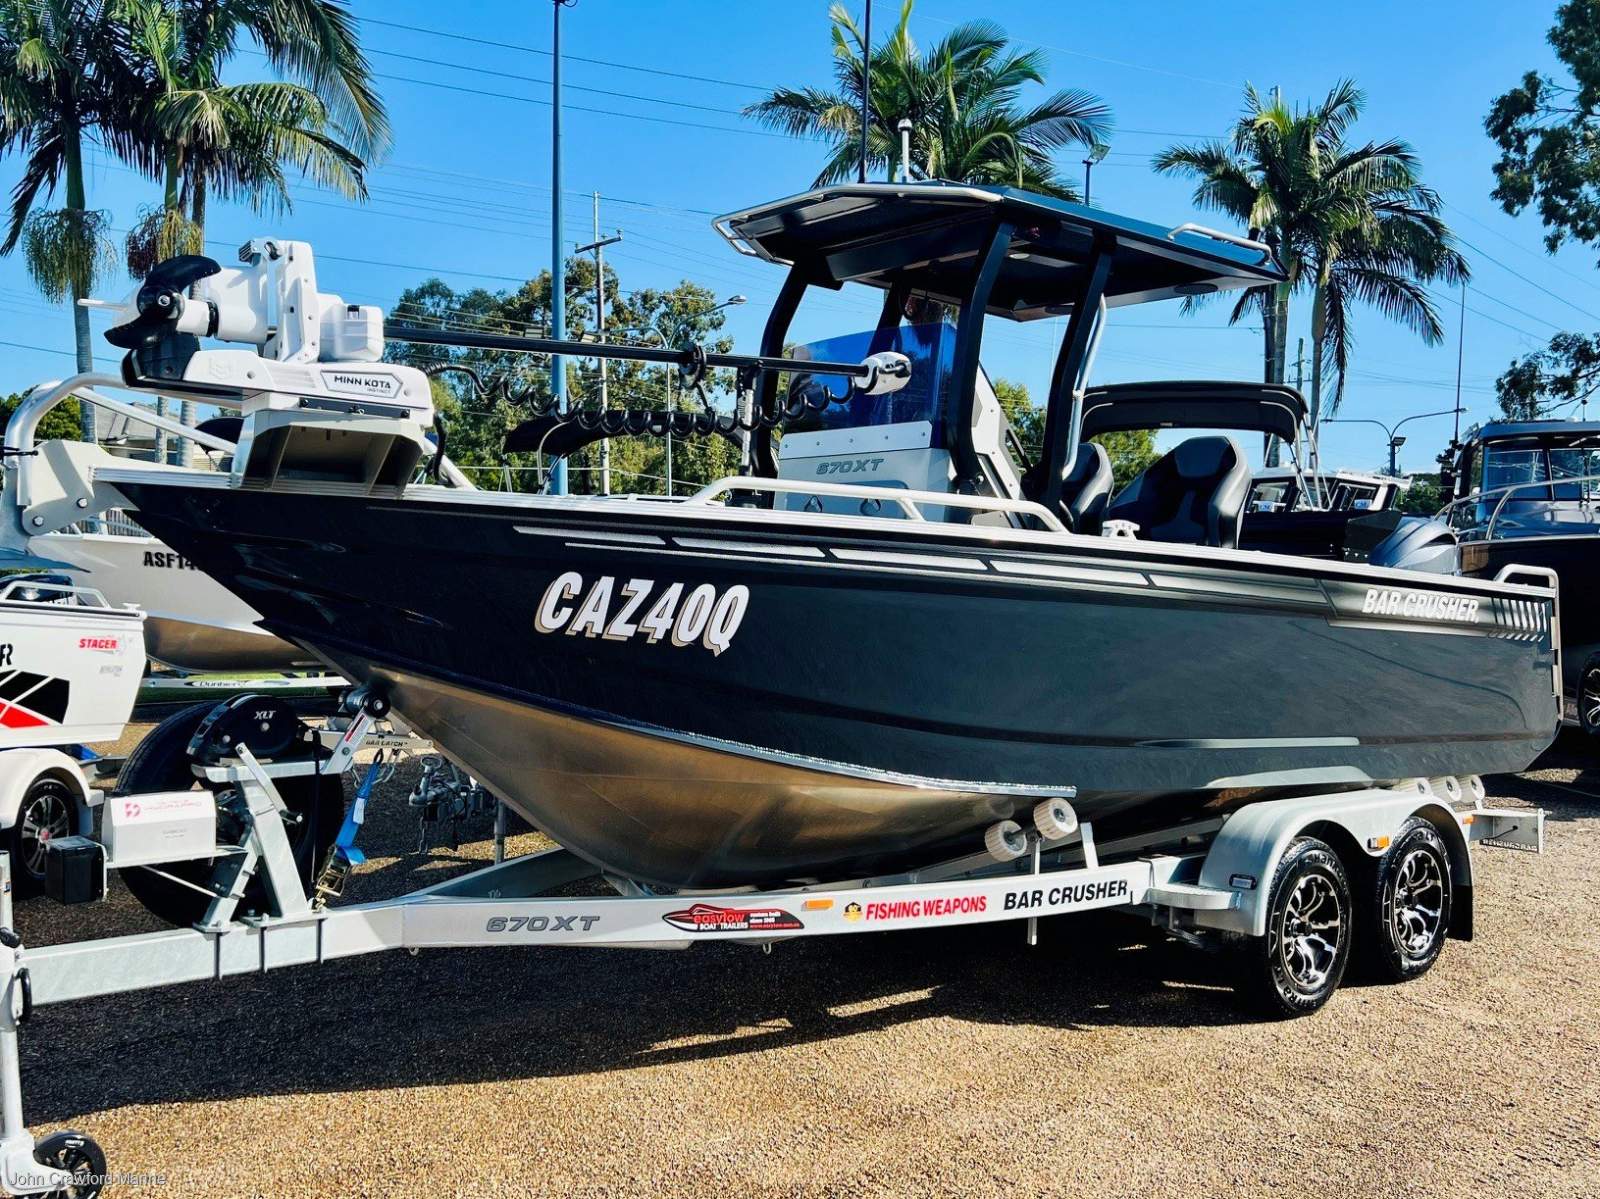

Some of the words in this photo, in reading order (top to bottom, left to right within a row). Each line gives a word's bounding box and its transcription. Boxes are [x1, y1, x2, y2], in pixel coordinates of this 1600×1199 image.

[334, 376, 362, 386] MINN
[364, 379, 391, 389] KOTA
[815, 457, 885, 475] 670XT
[1361, 588, 1402, 614] BAR
[1402, 592, 1479, 622] CRUSHER
[534, 571, 750, 658] CAZ40Q
[79, 638, 117, 649] STACER
[253, 710, 277, 720] XLT
[1003, 890, 1043, 911] BAR
[1049, 879, 1128, 905] CRUSHER
[866, 902, 920, 921] FISHING
[923, 895, 987, 917] WEAPONS
[486, 915, 601, 933] 670XT
[720, 921, 748, 931] TRAILERS
